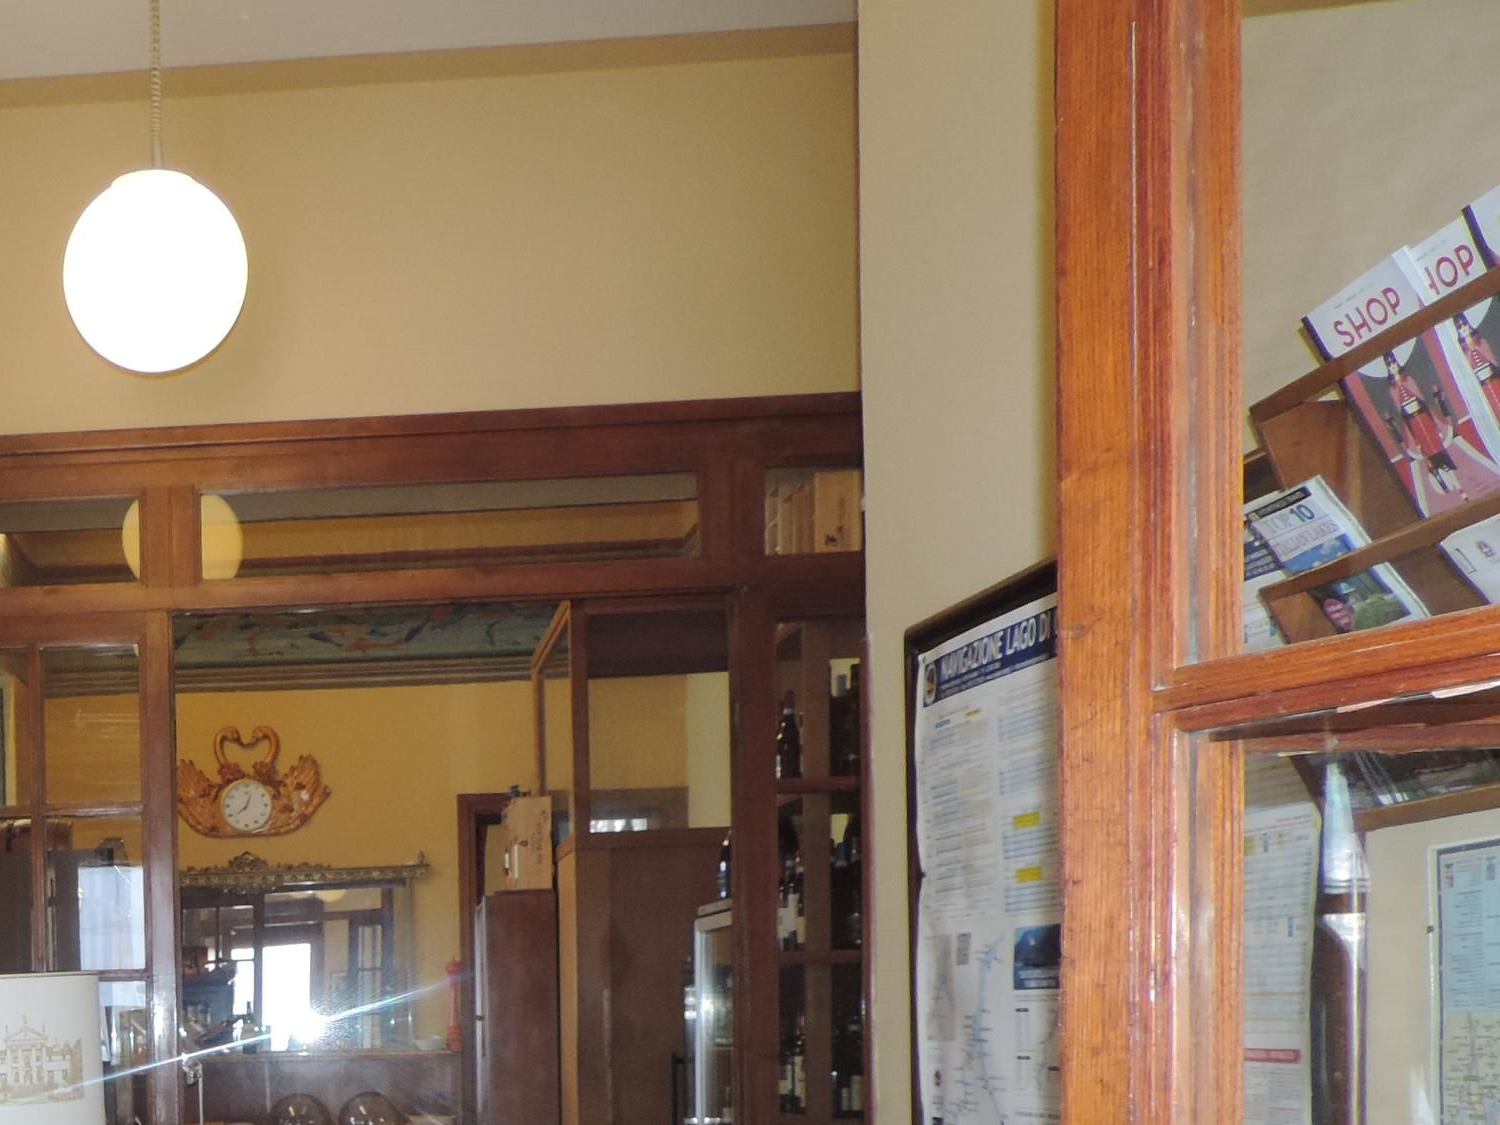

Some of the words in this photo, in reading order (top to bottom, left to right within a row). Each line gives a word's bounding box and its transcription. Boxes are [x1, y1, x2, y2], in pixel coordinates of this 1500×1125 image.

[1333, 287, 1400, 347] SHOP
[1264, 512, 1293, 534] TOP
[1289, 504, 1315, 523] 10
[940, 631, 1004, 682] NAVIGAZIONE
[1005, 617, 1037, 655] LAGO
[1038, 611, 1051, 643] DI
